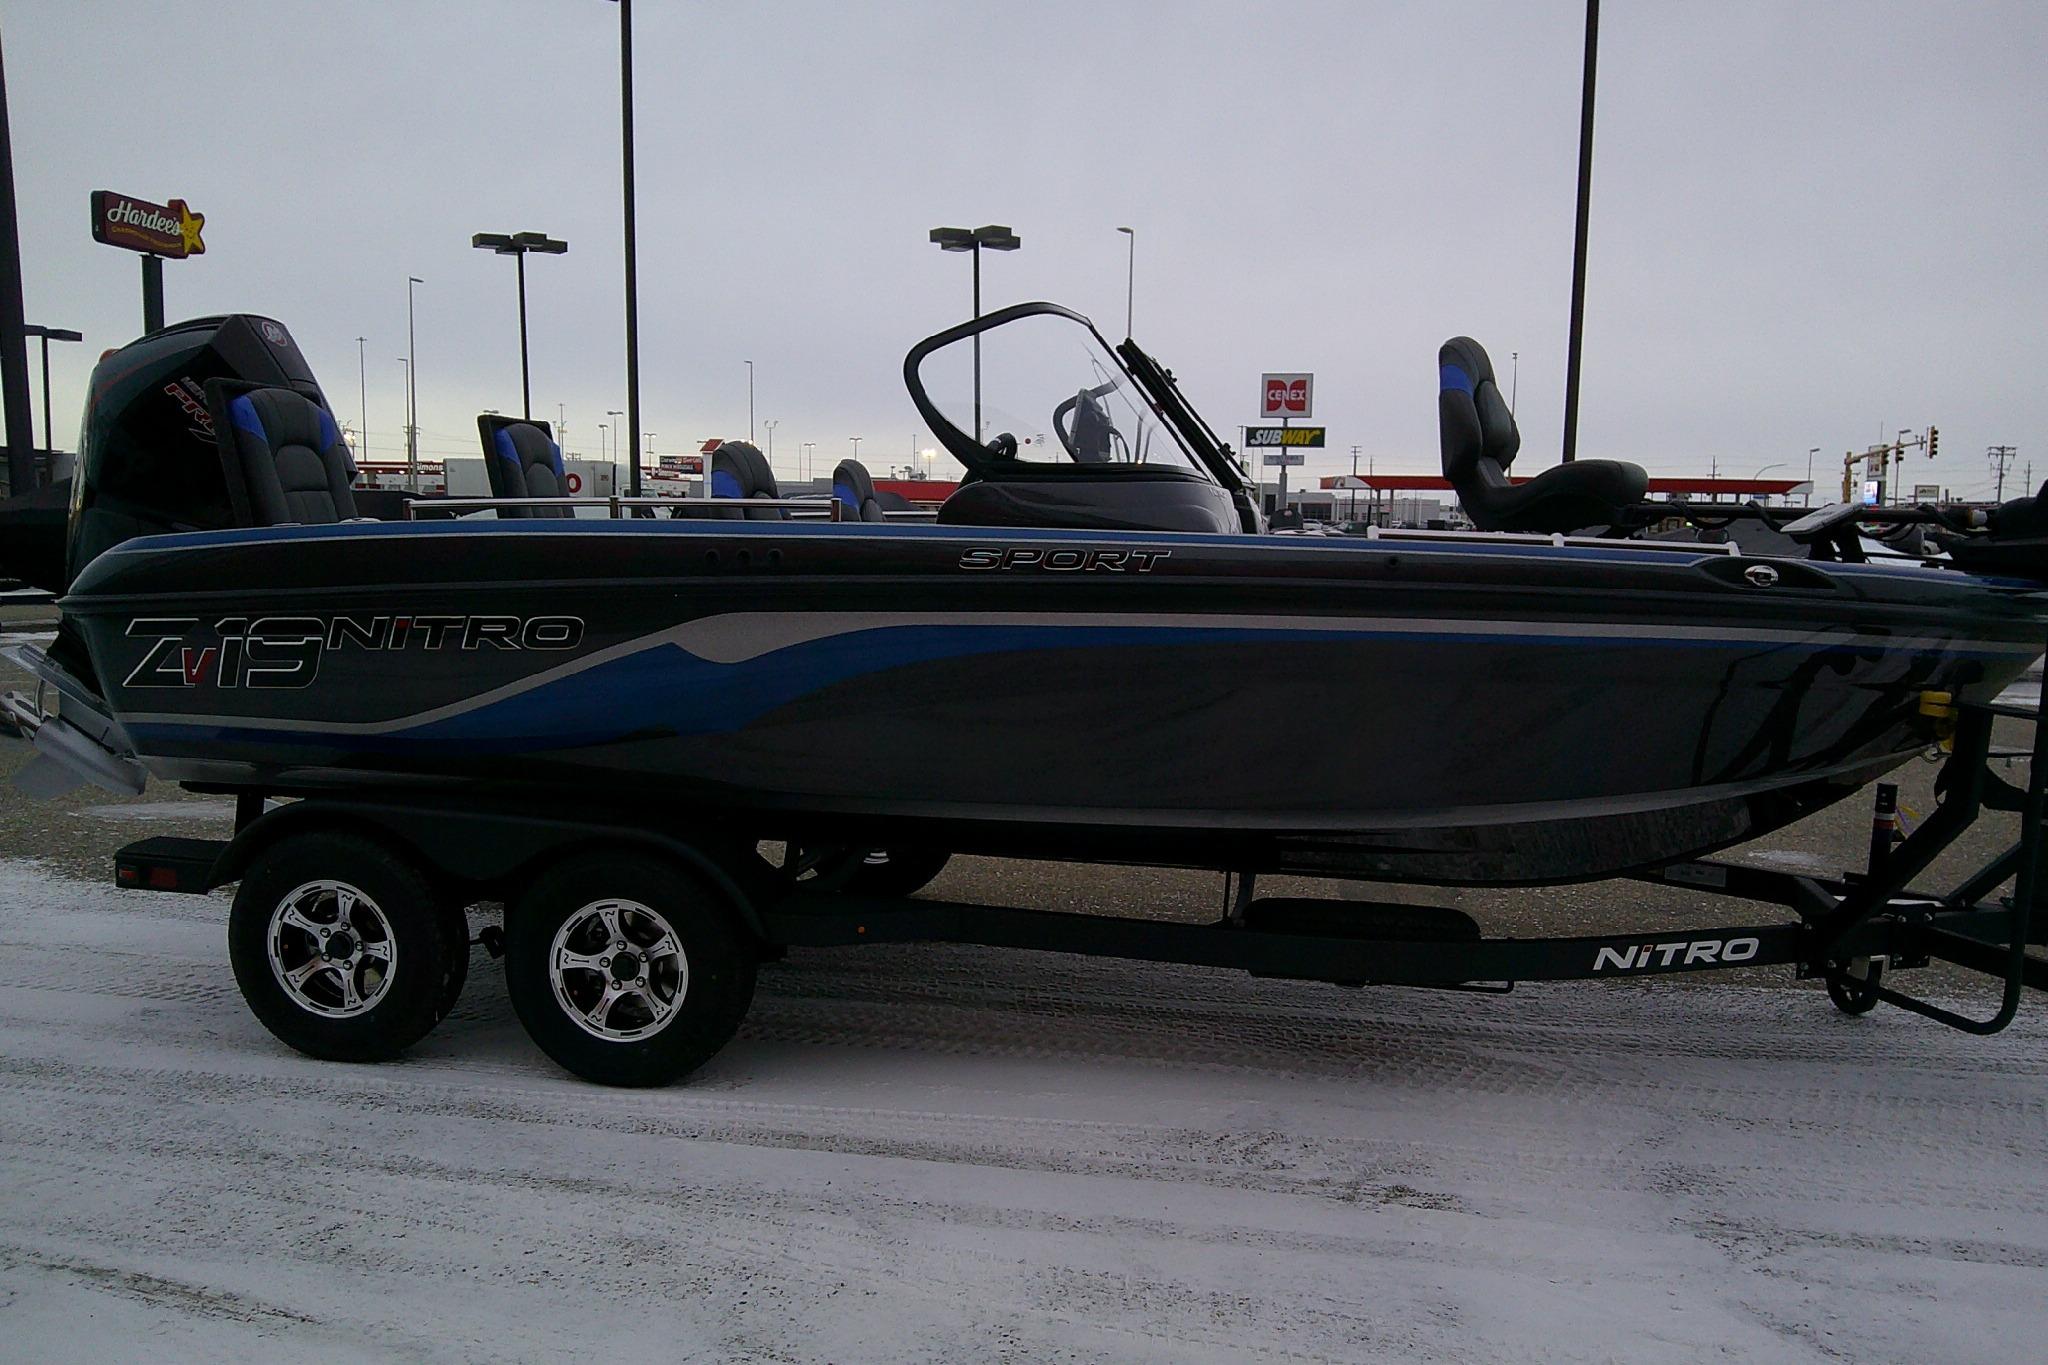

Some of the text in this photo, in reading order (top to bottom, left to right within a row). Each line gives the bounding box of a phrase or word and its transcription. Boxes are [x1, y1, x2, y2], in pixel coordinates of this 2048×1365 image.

[107, 200, 183, 236] Hardee's
[1268, 389, 1305, 400] CENEX
[1250, 429, 1321, 445] SUBWAY
[959, 547, 1172, 572] SPORT
